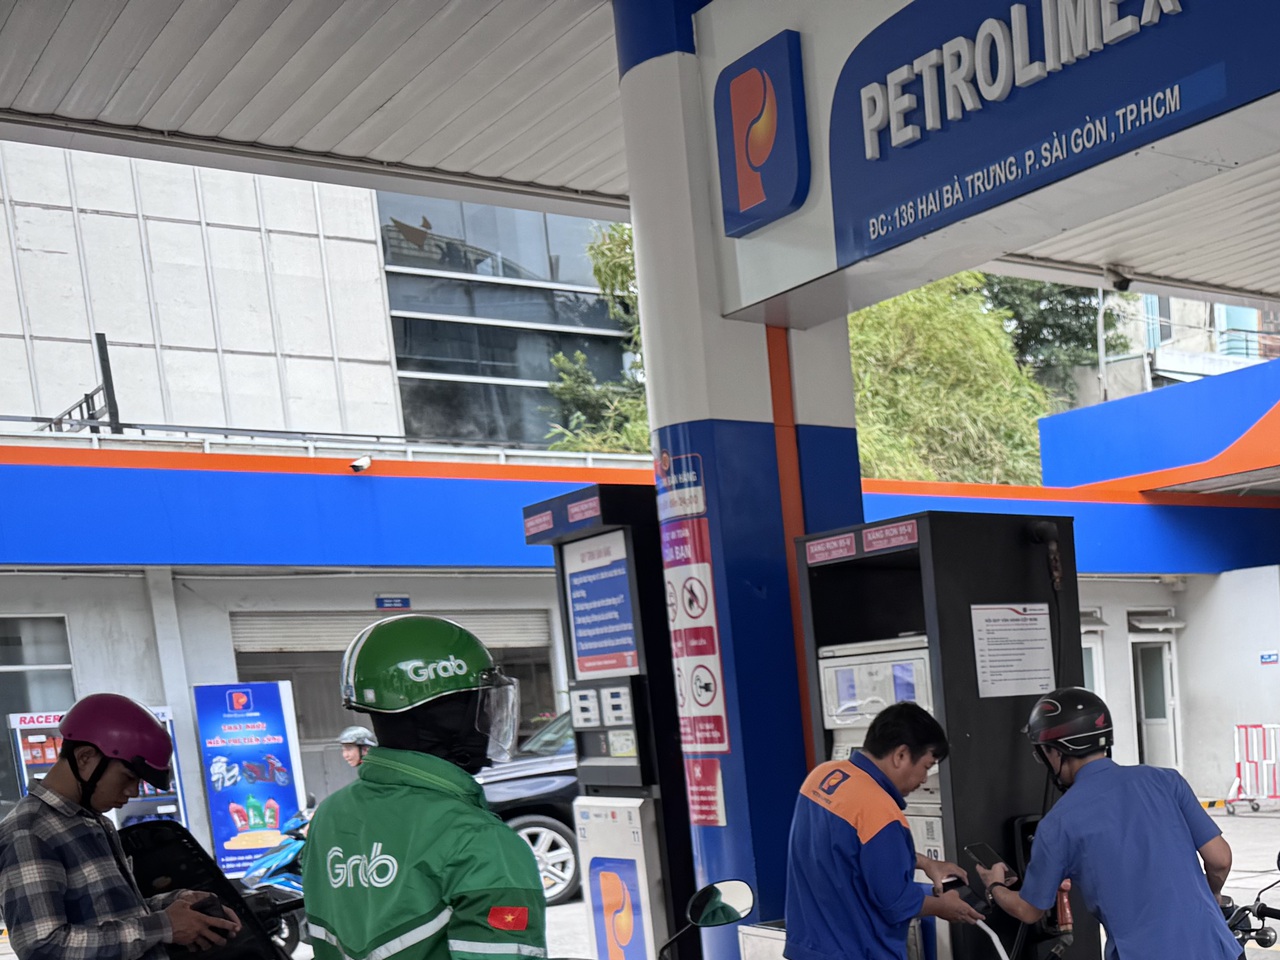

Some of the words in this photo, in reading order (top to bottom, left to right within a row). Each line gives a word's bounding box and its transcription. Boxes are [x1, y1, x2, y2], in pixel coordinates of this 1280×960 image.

[918, 191, 940, 220] HAI
[943, 175, 964, 208] BÀ
[1041, 132, 1067, 166] SÀI
[1116, 84, 1181, 134] TP.HCM
[408, 655, 468, 683] Grab
[327, 841, 398, 889] Grab
